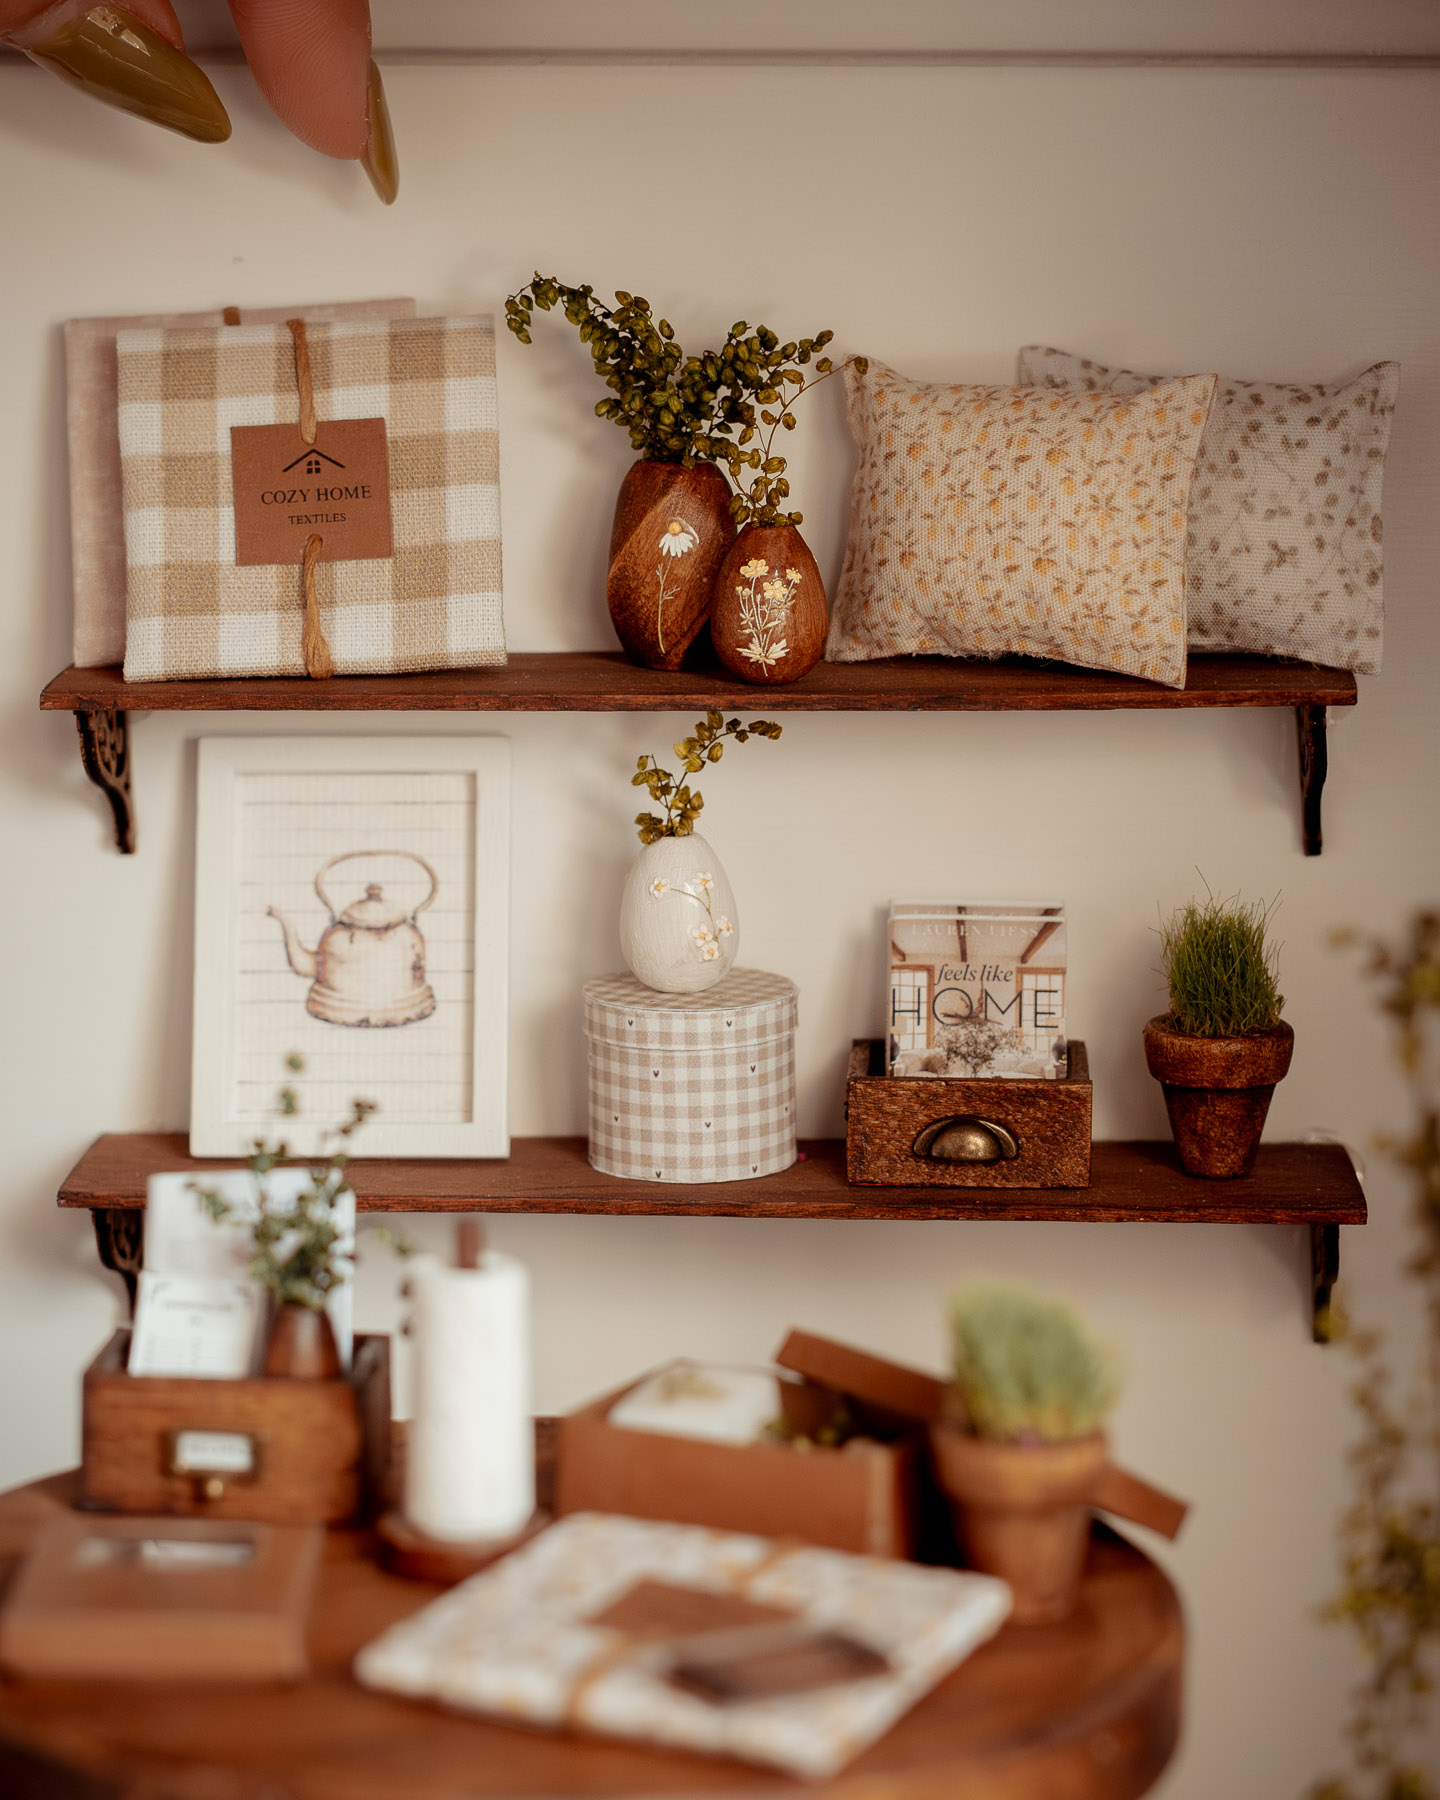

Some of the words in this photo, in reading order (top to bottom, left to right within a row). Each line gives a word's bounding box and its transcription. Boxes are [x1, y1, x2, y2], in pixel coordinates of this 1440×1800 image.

[260, 489, 310, 505] COZY
[317, 485, 372, 502] HOME
[288, 513, 347, 525] TEXTILES
[933, 963, 977, 985] feels
[980, 964, 1014, 983] like
[892, 987, 1059, 1029] HOME
